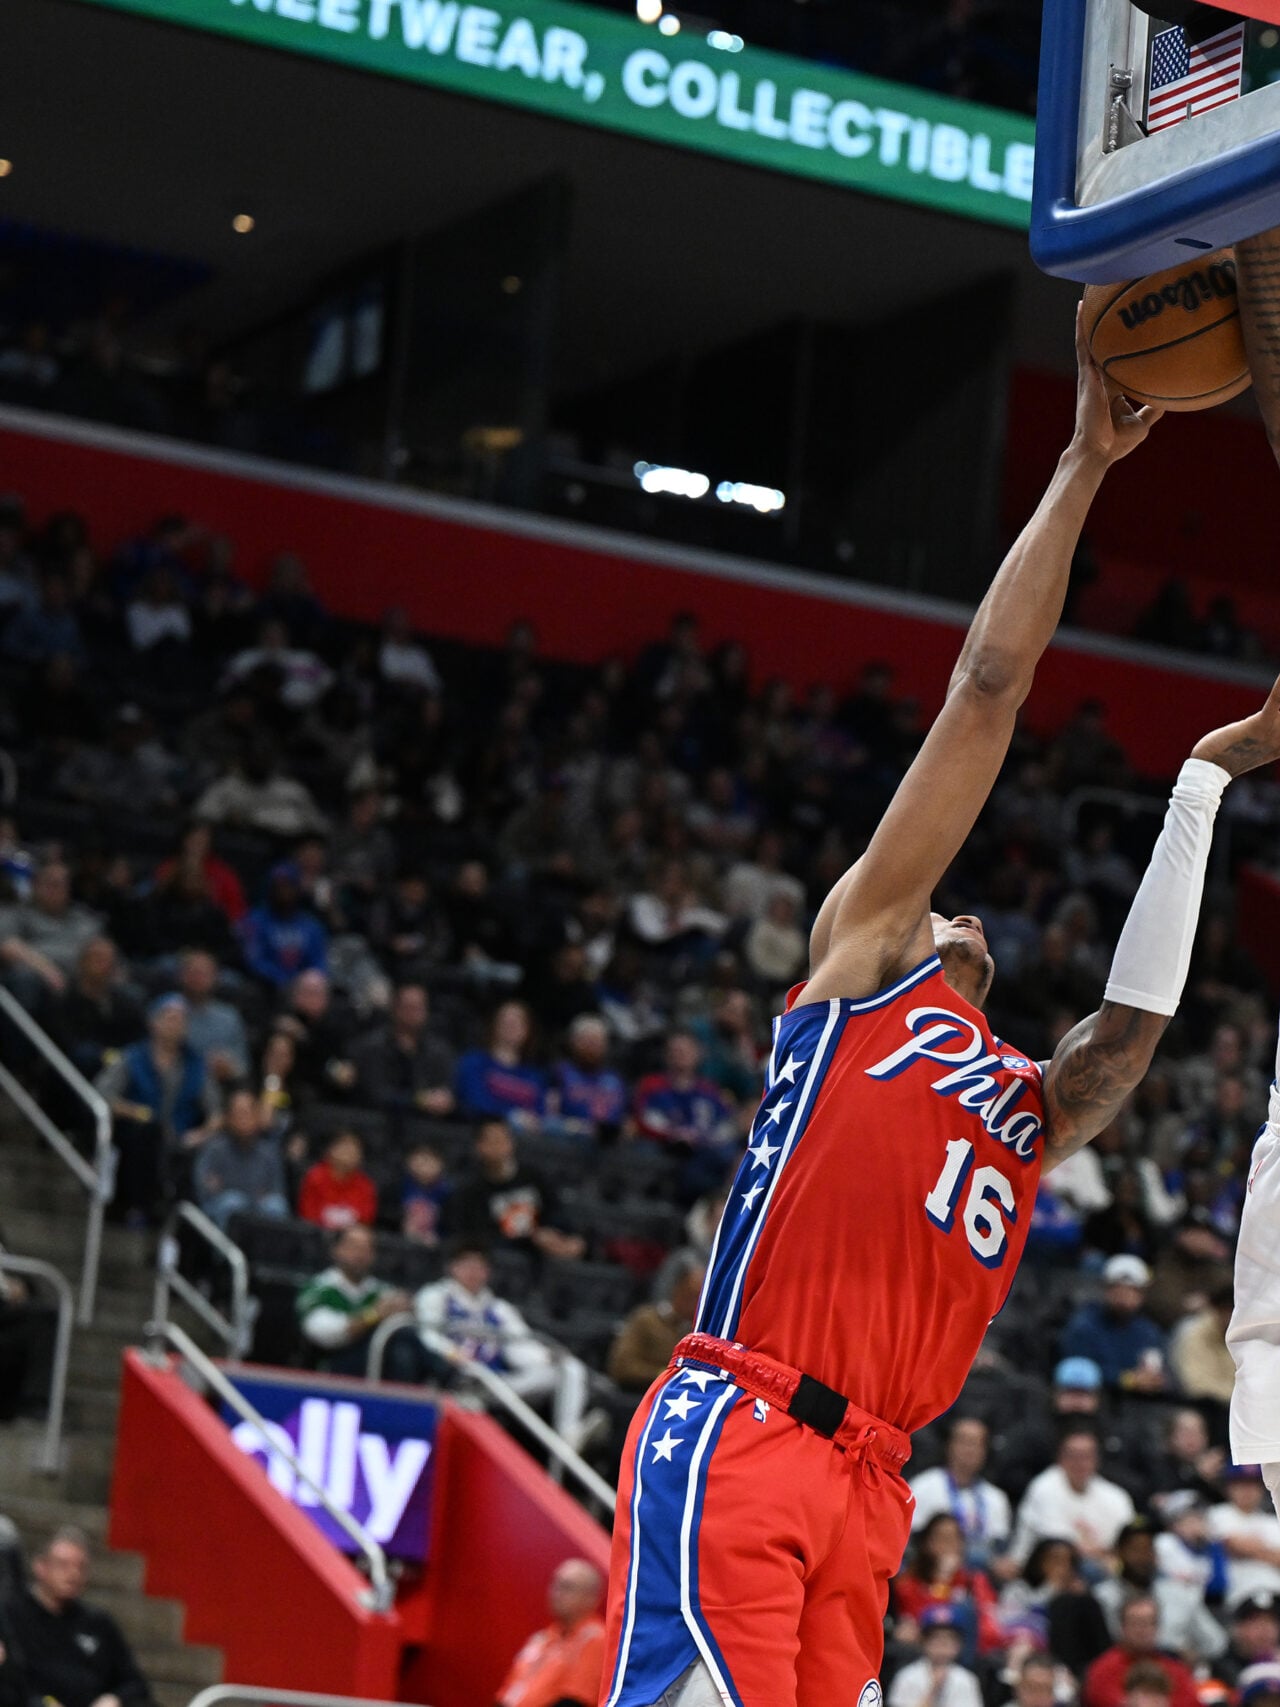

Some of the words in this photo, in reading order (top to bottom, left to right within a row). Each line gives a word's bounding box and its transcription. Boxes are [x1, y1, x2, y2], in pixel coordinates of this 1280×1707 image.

[230, 0, 605, 103] ETWEAR,
[925, 1137, 1018, 1270] 16
[230, 1397, 432, 1543] ally
